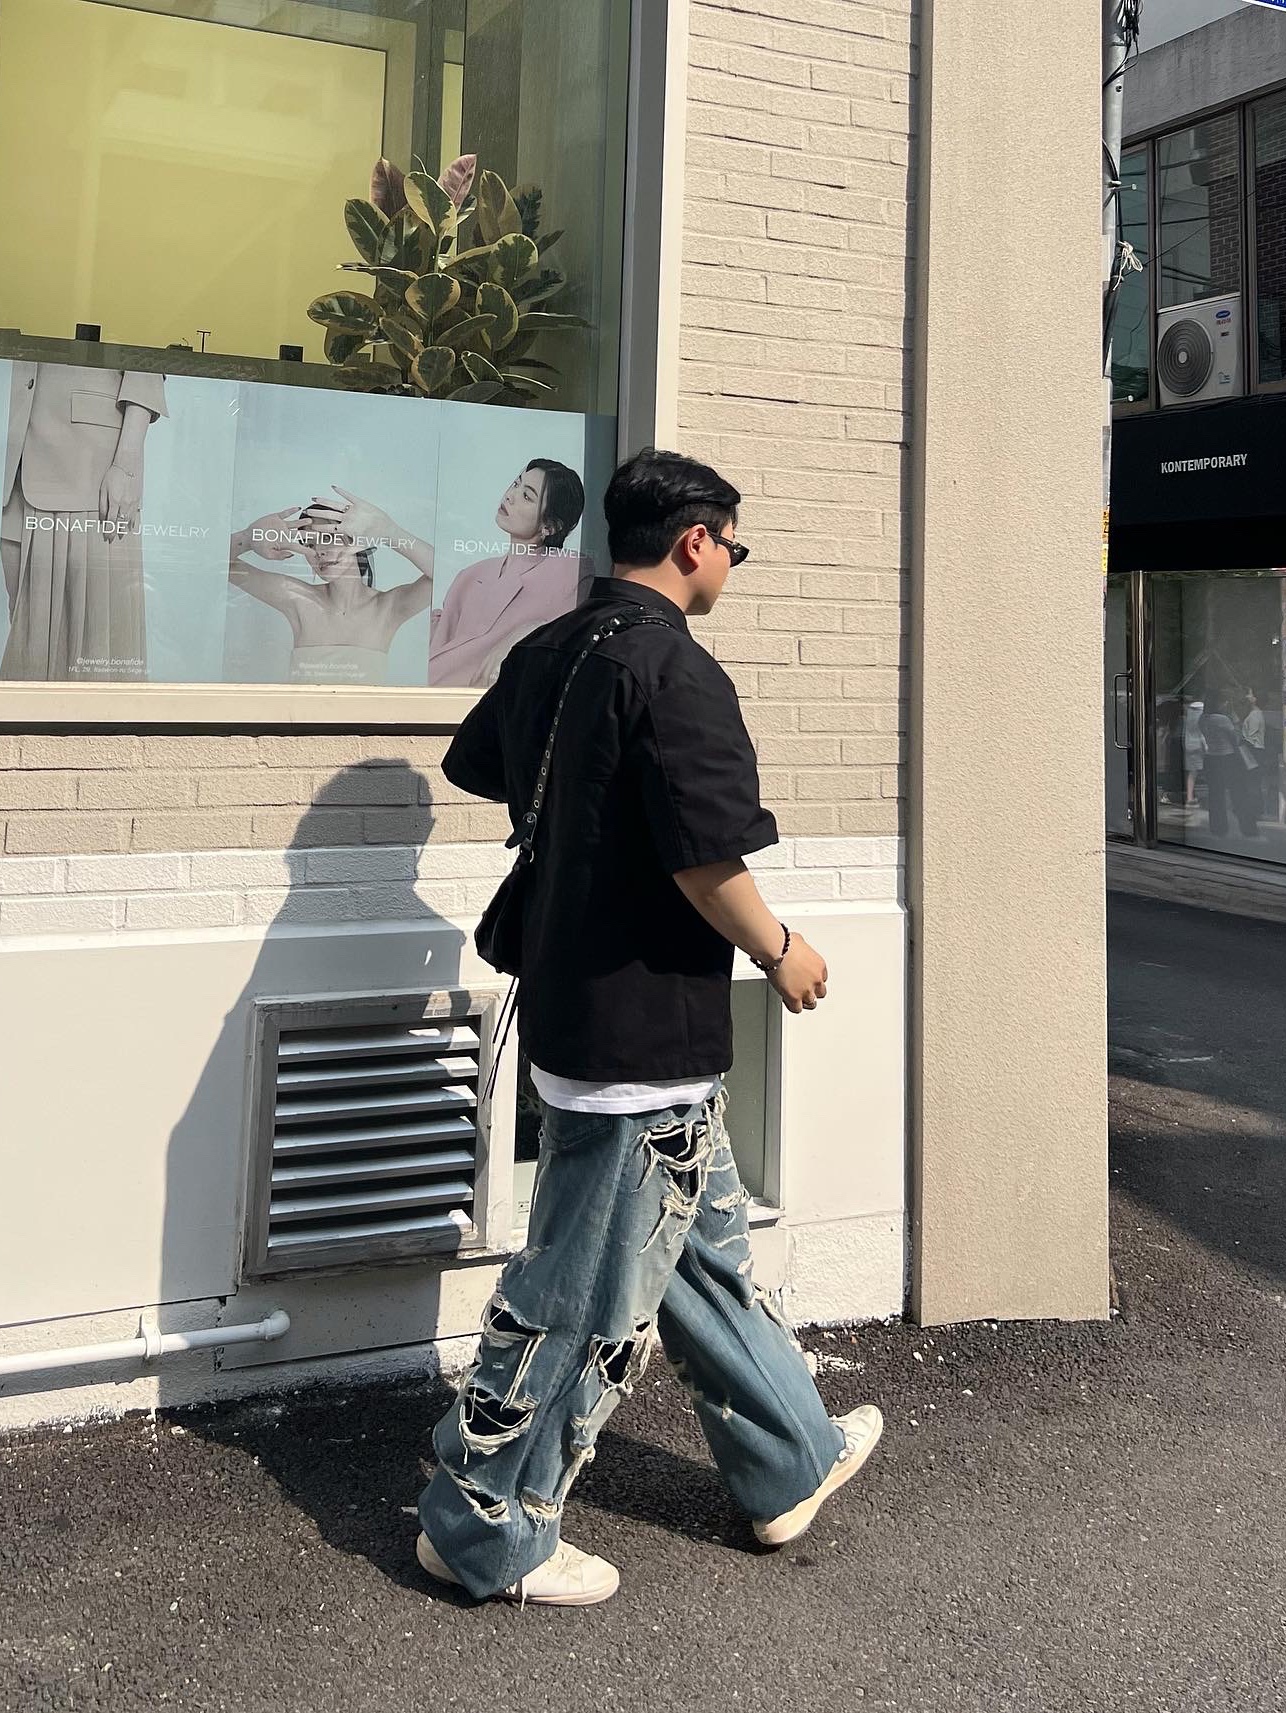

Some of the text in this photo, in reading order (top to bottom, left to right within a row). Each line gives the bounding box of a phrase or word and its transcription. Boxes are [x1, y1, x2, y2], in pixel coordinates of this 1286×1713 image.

[1161, 453, 1248, 474] KONTEMPORARY
[25, 516, 210, 538] BONAFIDE JEWELRY
[252, 528, 417, 550] BONAFIDE JEWELRY
[453, 539, 538, 556] BONAFIDE
